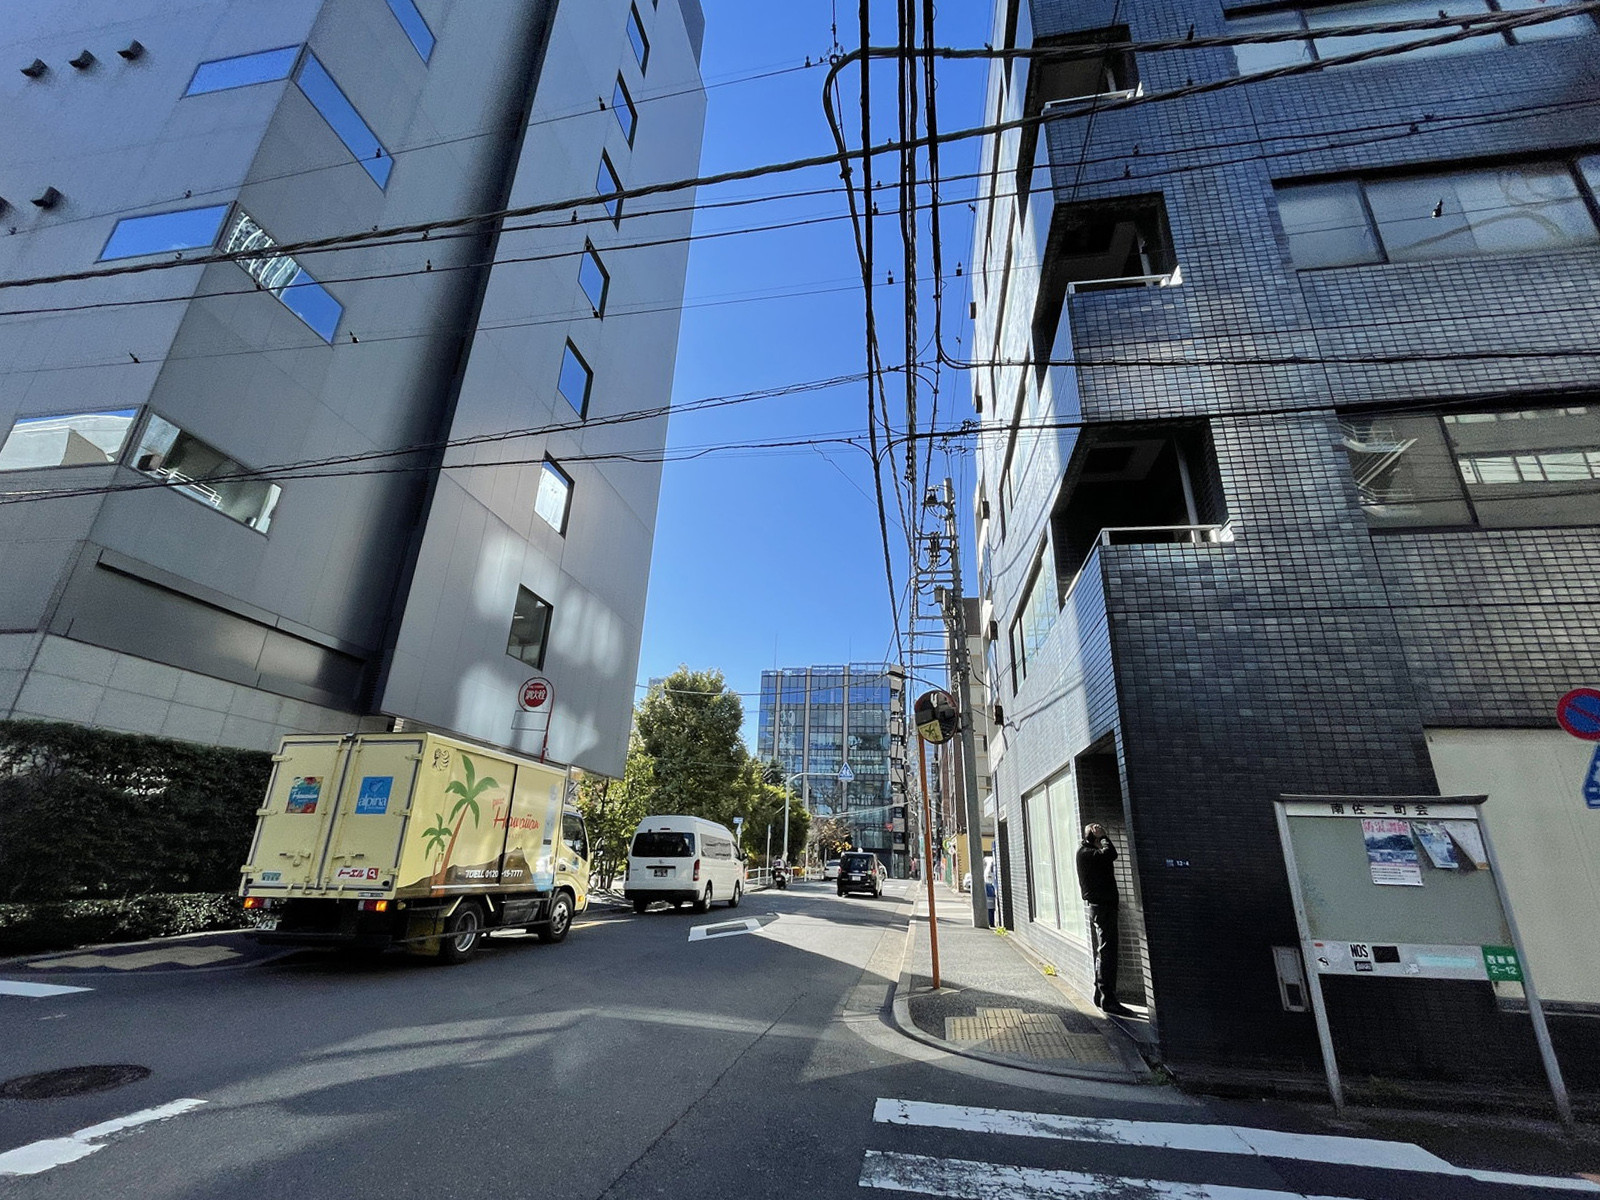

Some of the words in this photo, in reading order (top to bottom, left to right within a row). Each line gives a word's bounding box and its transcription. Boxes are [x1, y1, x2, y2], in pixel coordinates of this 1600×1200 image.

[358, 793, 387, 811] alpina
[1330, 802, 1429, 816] 南佐二町会
[1491, 965, 1518, 976] 2-12
